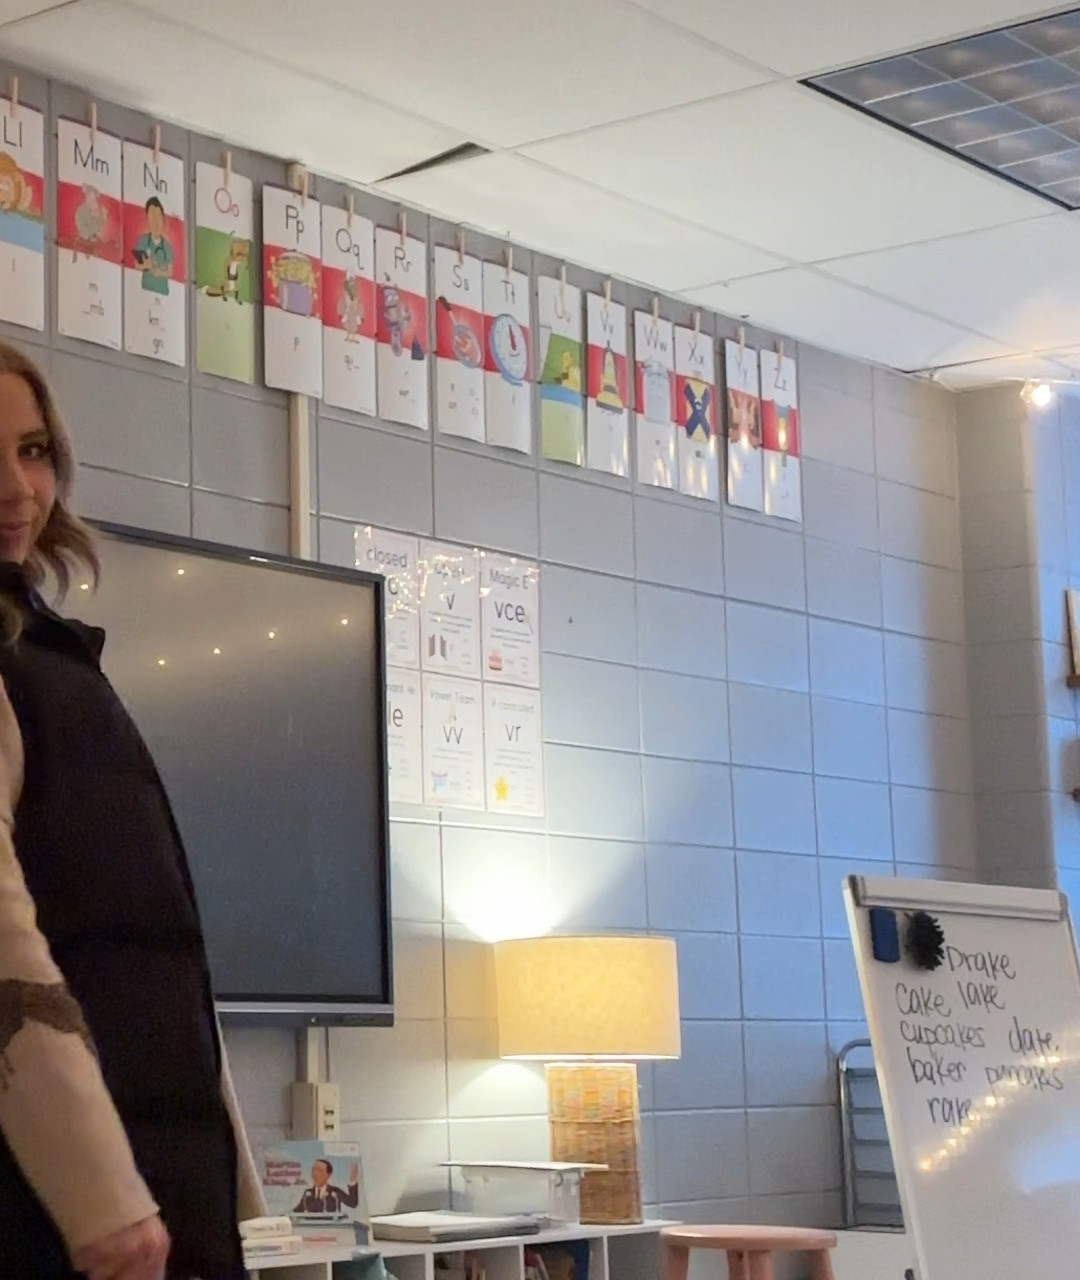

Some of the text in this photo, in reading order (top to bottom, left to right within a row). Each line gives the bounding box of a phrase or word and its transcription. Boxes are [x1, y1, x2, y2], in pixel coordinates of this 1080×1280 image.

[3, 115, 23, 149] Ll
[73, 138, 110, 176] Mm
[143, 162, 168, 195] Nn
[213, 186, 240, 218] Oo
[285, 204, 305, 244] Pp
[335, 227, 365, 271] Qq
[394, 246, 413, 273] Rr
[452, 264, 470, 292] Ss
[501, 279, 517, 306] Tt
[600, 309, 615, 335] Vv
[642, 324, 668, 353] Ww
[687, 340, 706, 366] Xx
[773, 366, 788, 392] Zz
[366, 547, 408, 569] closed
[489, 567, 529, 590] Magic E
[494, 600, 526, 623] vce
[946, 945, 1017, 981] Drake
[957, 980, 1006, 1015] lake
[900, 1019, 986, 1059] cupcakes
[906, 1046, 967, 1087] baker
[927, 1096, 972, 1127] rake
